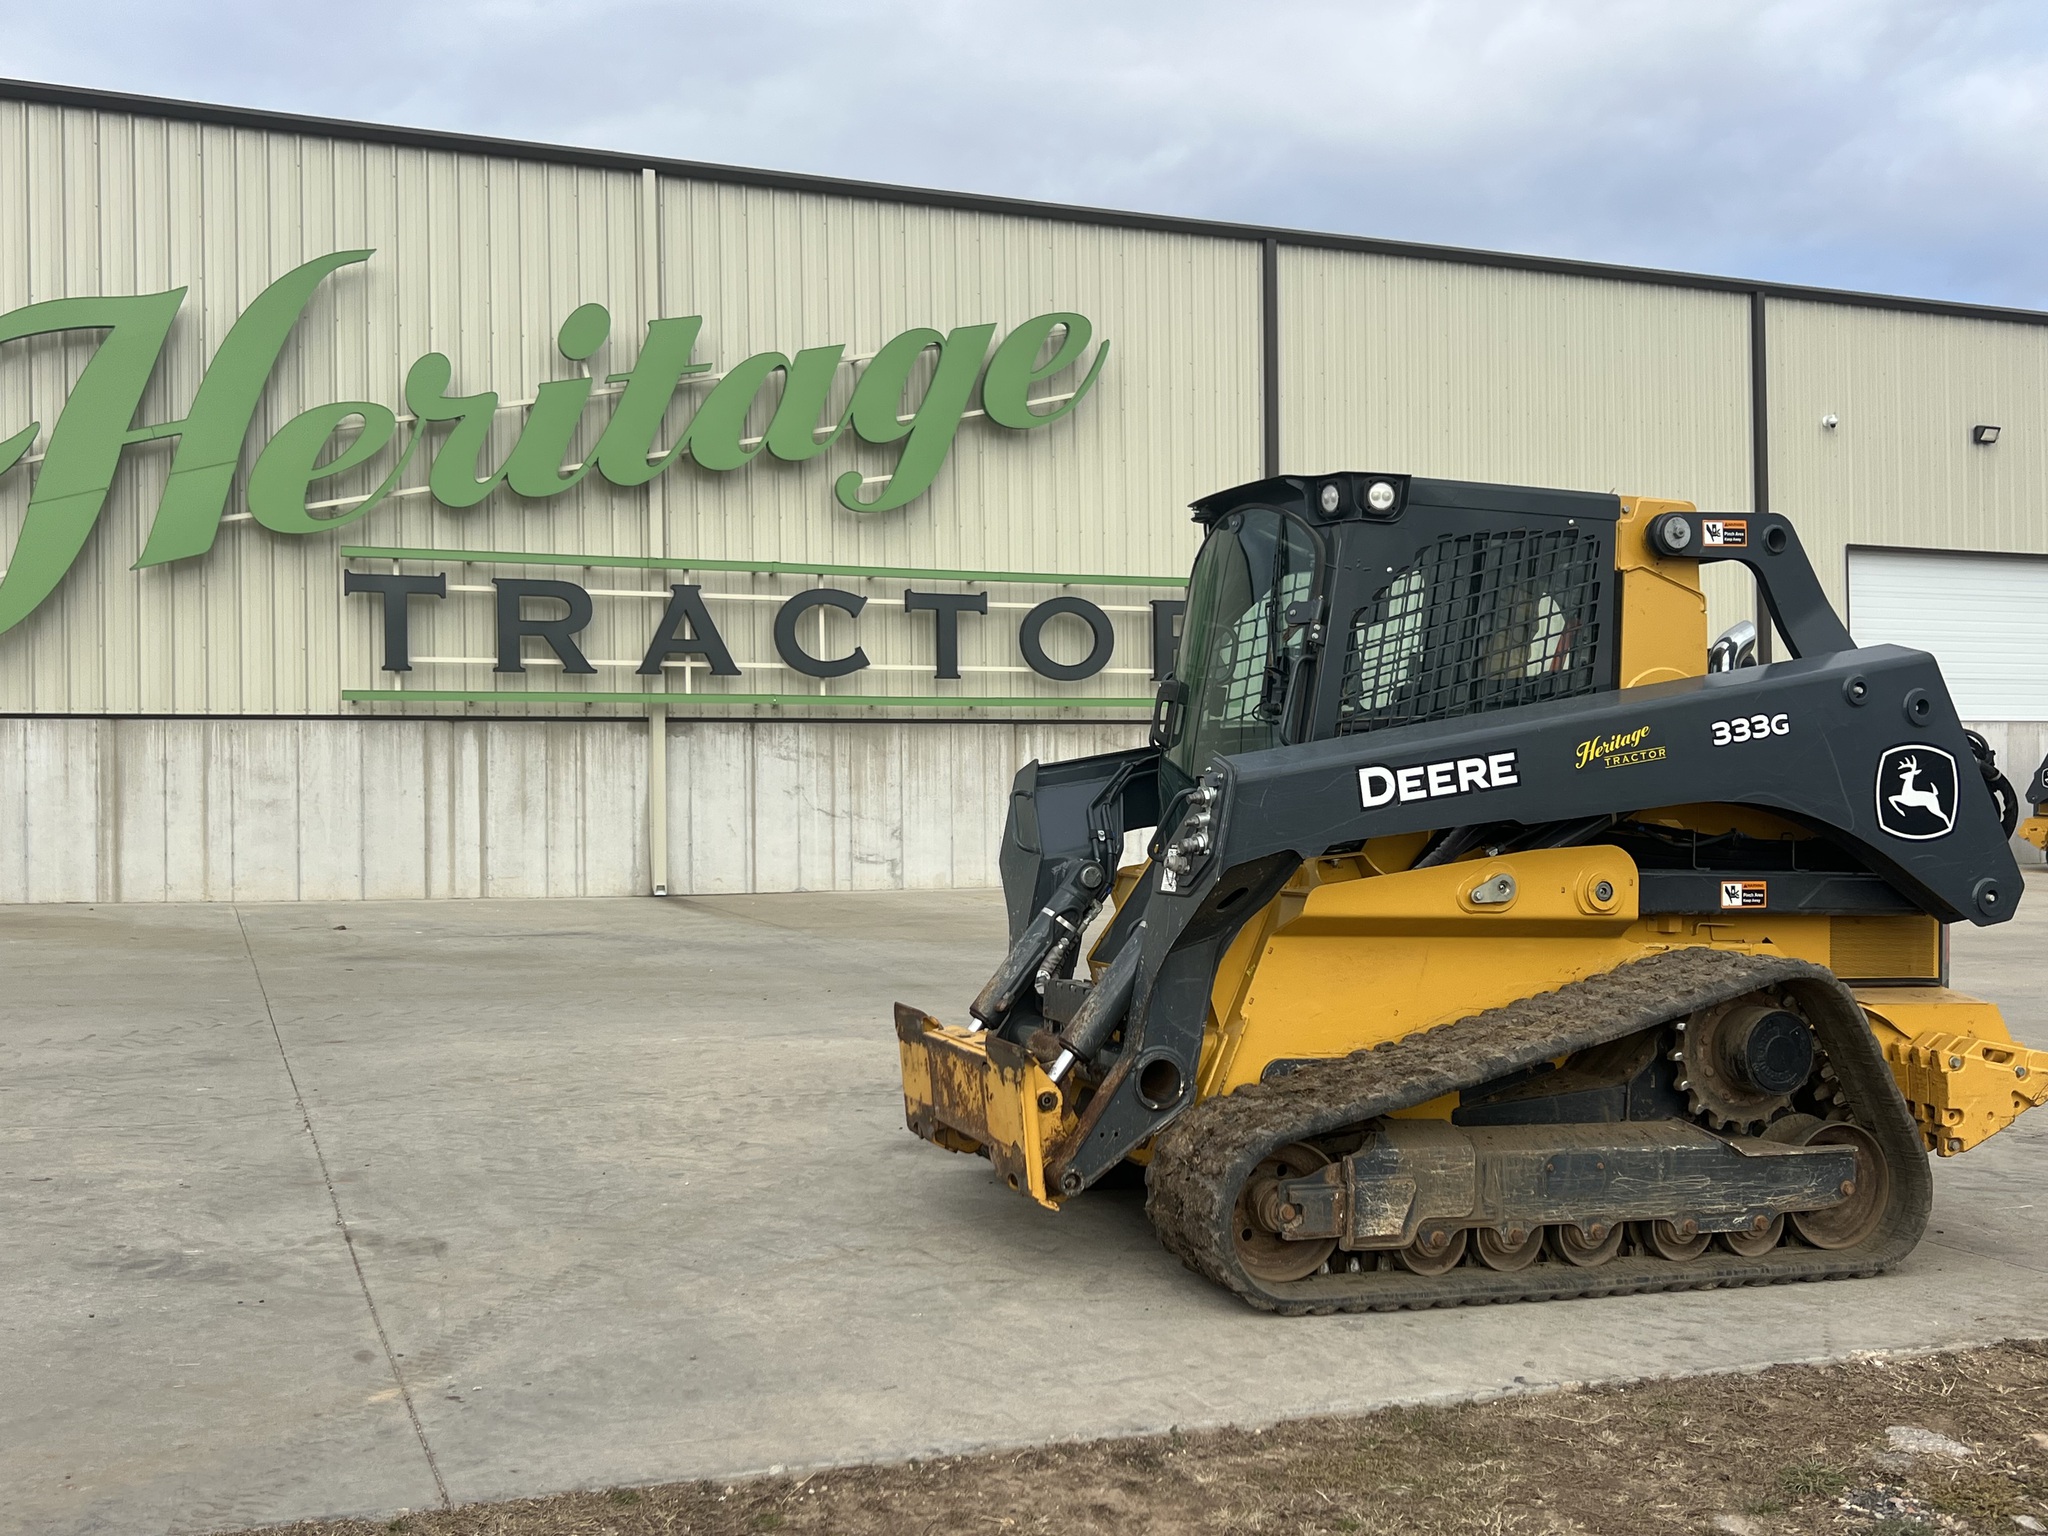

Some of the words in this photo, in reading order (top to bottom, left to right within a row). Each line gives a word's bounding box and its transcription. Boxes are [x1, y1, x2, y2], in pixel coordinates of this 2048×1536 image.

[0, 249, 1109, 635] Heritage
[1575, 725, 1651, 769] Heritage
[1711, 713, 1790, 746] 333G
[1603, 748, 1666, 766] TRACTOR
[1358, 751, 1519, 808] DEERE
